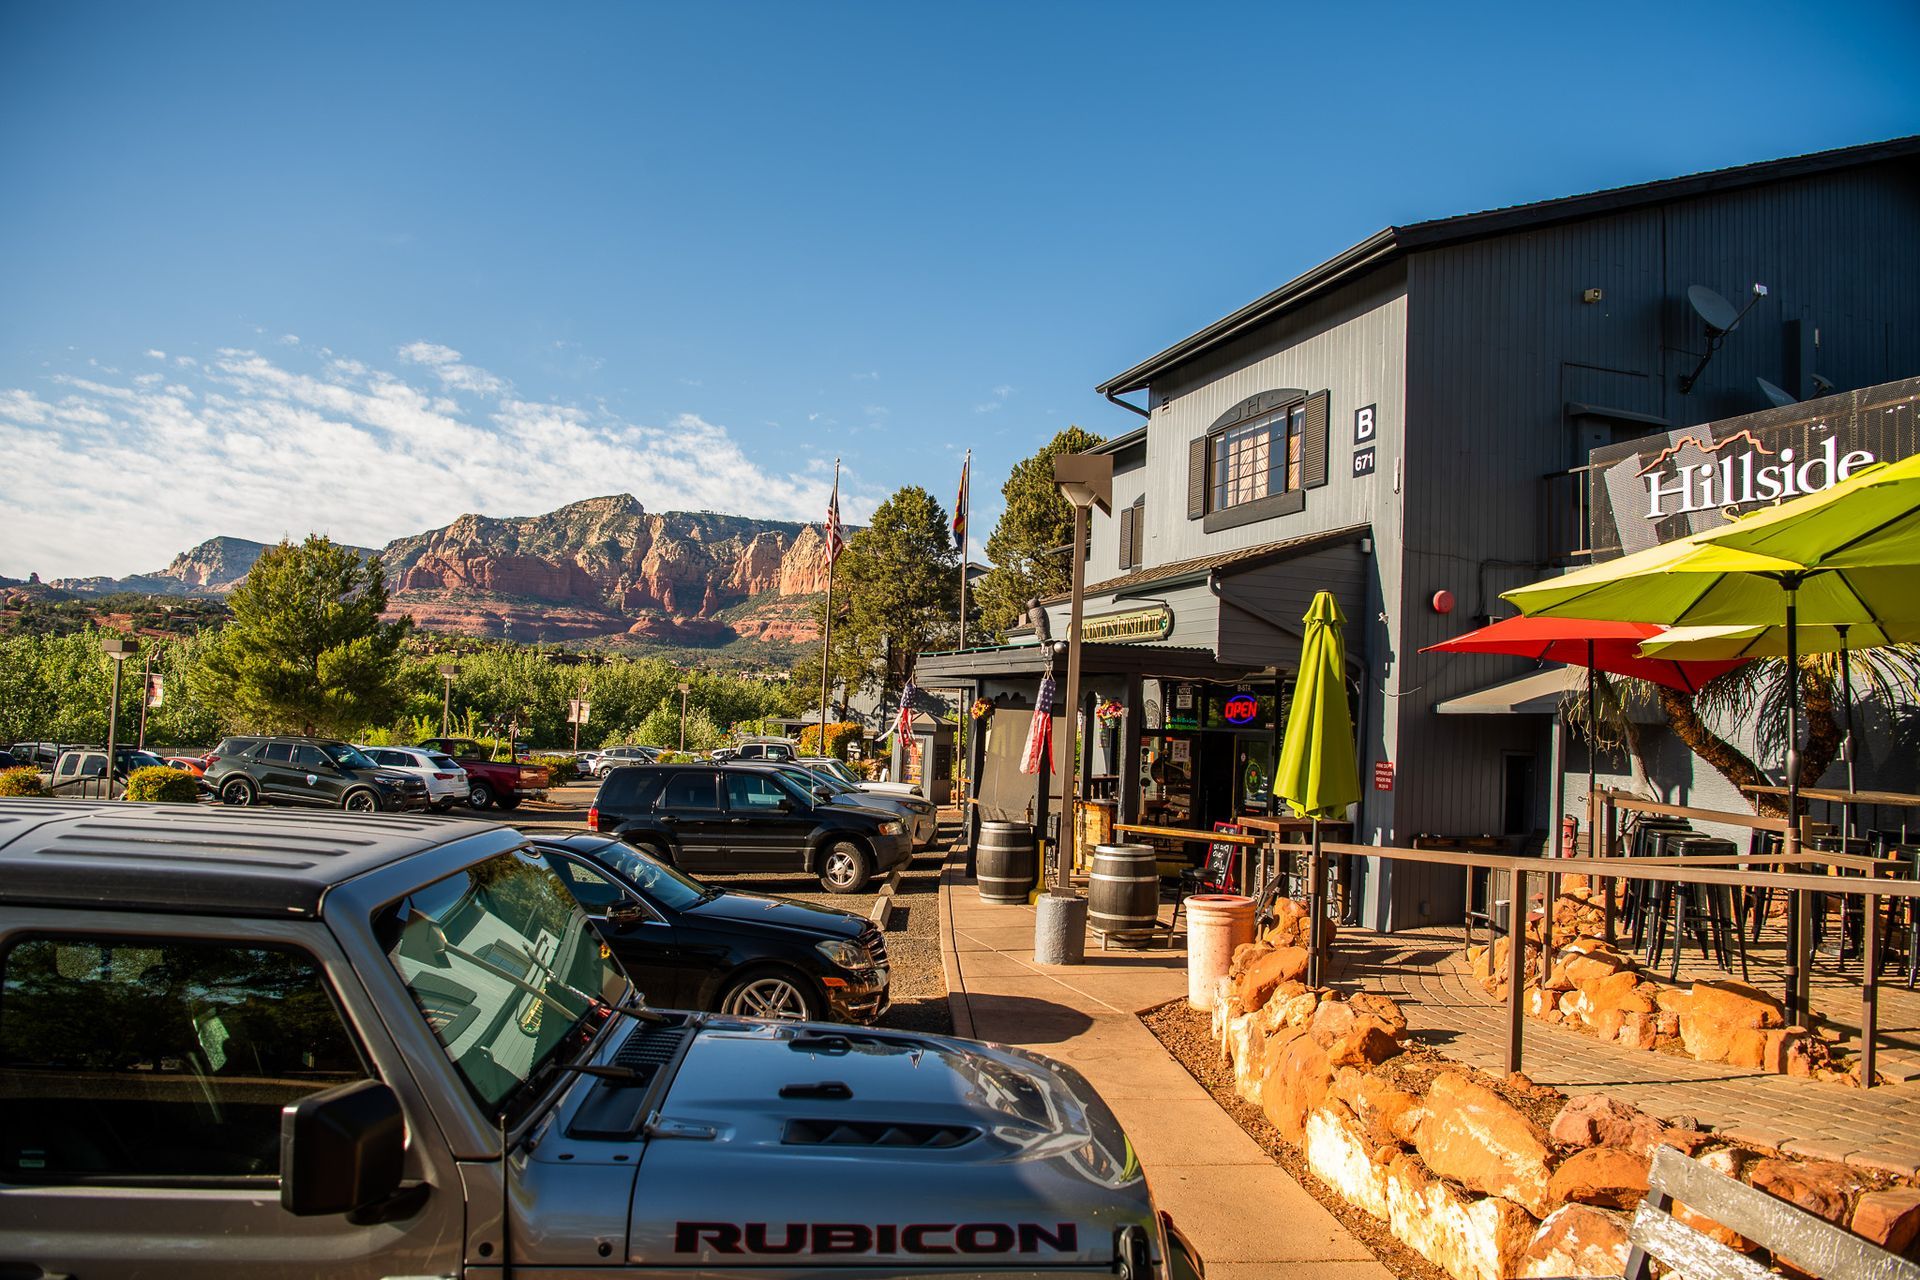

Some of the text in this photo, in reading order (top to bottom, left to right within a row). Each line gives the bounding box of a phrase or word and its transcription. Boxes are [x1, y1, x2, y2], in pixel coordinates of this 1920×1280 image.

[1358, 408, 1373, 440] B
[1355, 452, 1374, 472] 671
[1644, 435, 1876, 519] Hillside
[1225, 701, 1258, 719] OPEN
[674, 1221, 1079, 1254] RUBICON
